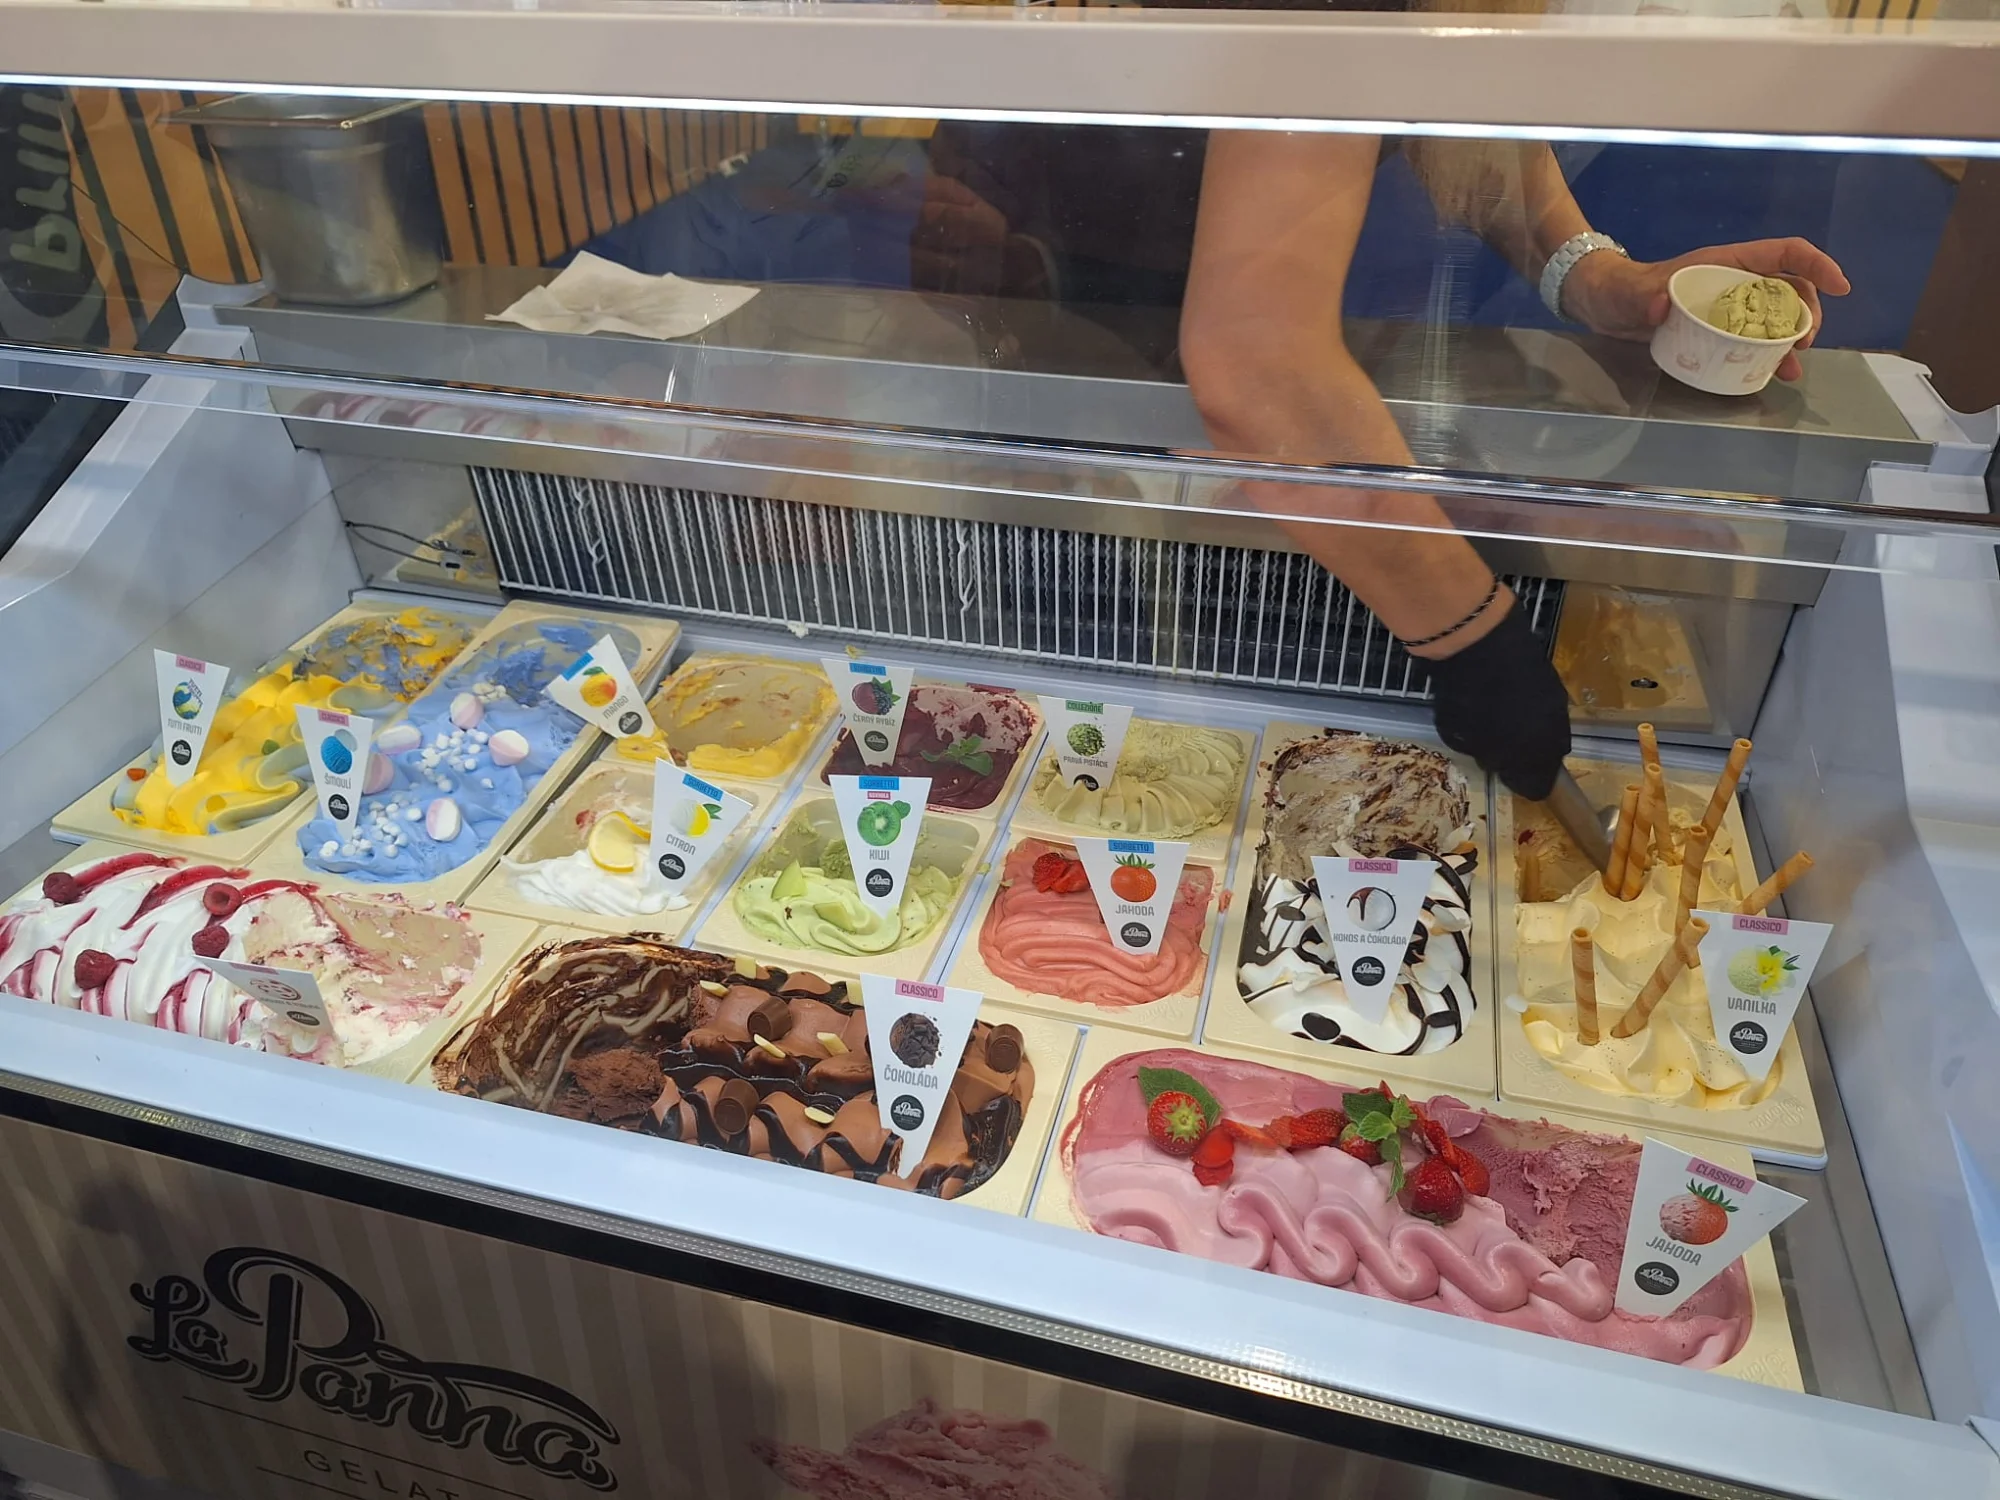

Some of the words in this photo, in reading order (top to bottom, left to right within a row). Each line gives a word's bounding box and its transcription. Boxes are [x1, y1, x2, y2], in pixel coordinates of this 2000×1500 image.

[602, 695, 630, 720] MANGO
[167, 718, 182, 731] TUTTI
[182, 723, 203, 736] FRUTTI
[665, 833, 697, 856] CITRON
[1113, 842, 1150, 852] SORBETTO
[869, 849, 890, 861] KIWI
[1354, 861, 1392, 872] CLASSICO
[1115, 904, 1155, 917] JAHODA
[1739, 918, 1782, 932] CLASSICO
[1333, 933, 1358, 943] KOKOS
[1360, 935, 1366, 943] A
[1367, 933, 1407, 945] ČOKOLÁDA
[901, 983, 939, 999] CLASSICO
[1727, 996, 1777, 1016] VANILKA
[884, 1064, 939, 1090] ČOKOLÁDA
[1695, 1163, 1746, 1190] CLASSICO
[1645, 1236, 1703, 1266] JAHODA
[126, 1275, 257, 1384] La
[203, 1246, 621, 1492] Panna
